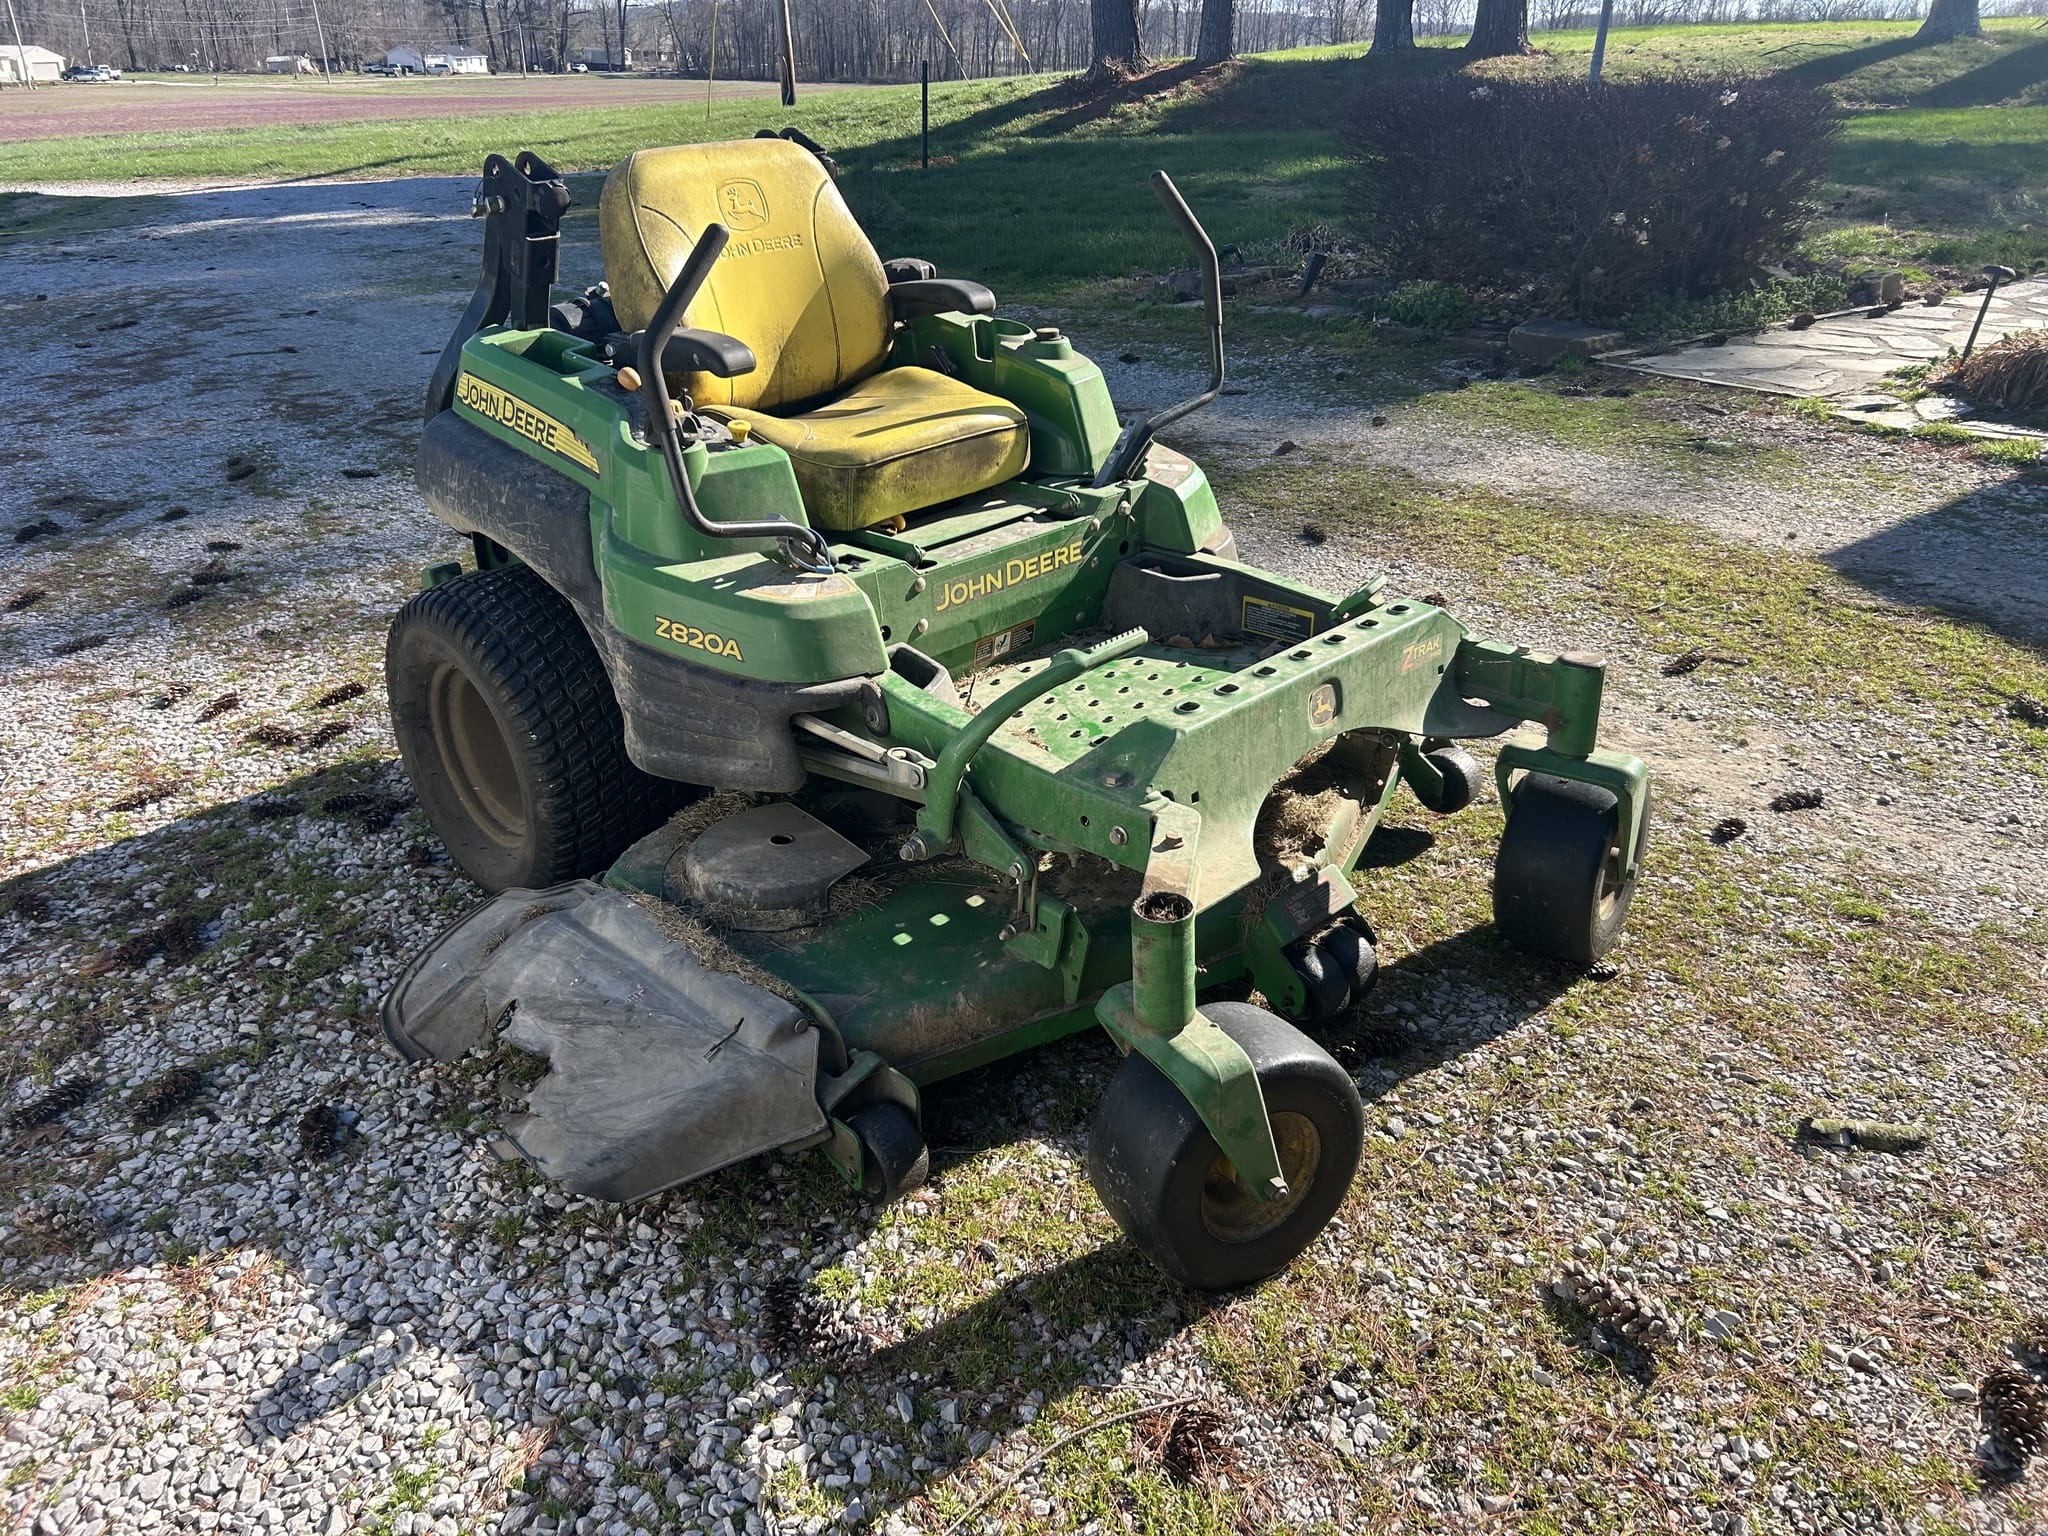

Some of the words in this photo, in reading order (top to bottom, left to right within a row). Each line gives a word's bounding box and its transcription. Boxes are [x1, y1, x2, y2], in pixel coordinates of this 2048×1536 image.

[719, 241, 751, 259] OHN
[751, 234, 803, 254] DEERE
[462, 378, 500, 419] JOHN
[502, 397, 558, 448] DEERE
[936, 569, 1003, 612] JOHN
[1006, 541, 1083, 586] DEERE
[655, 615, 744, 662] Z820A
